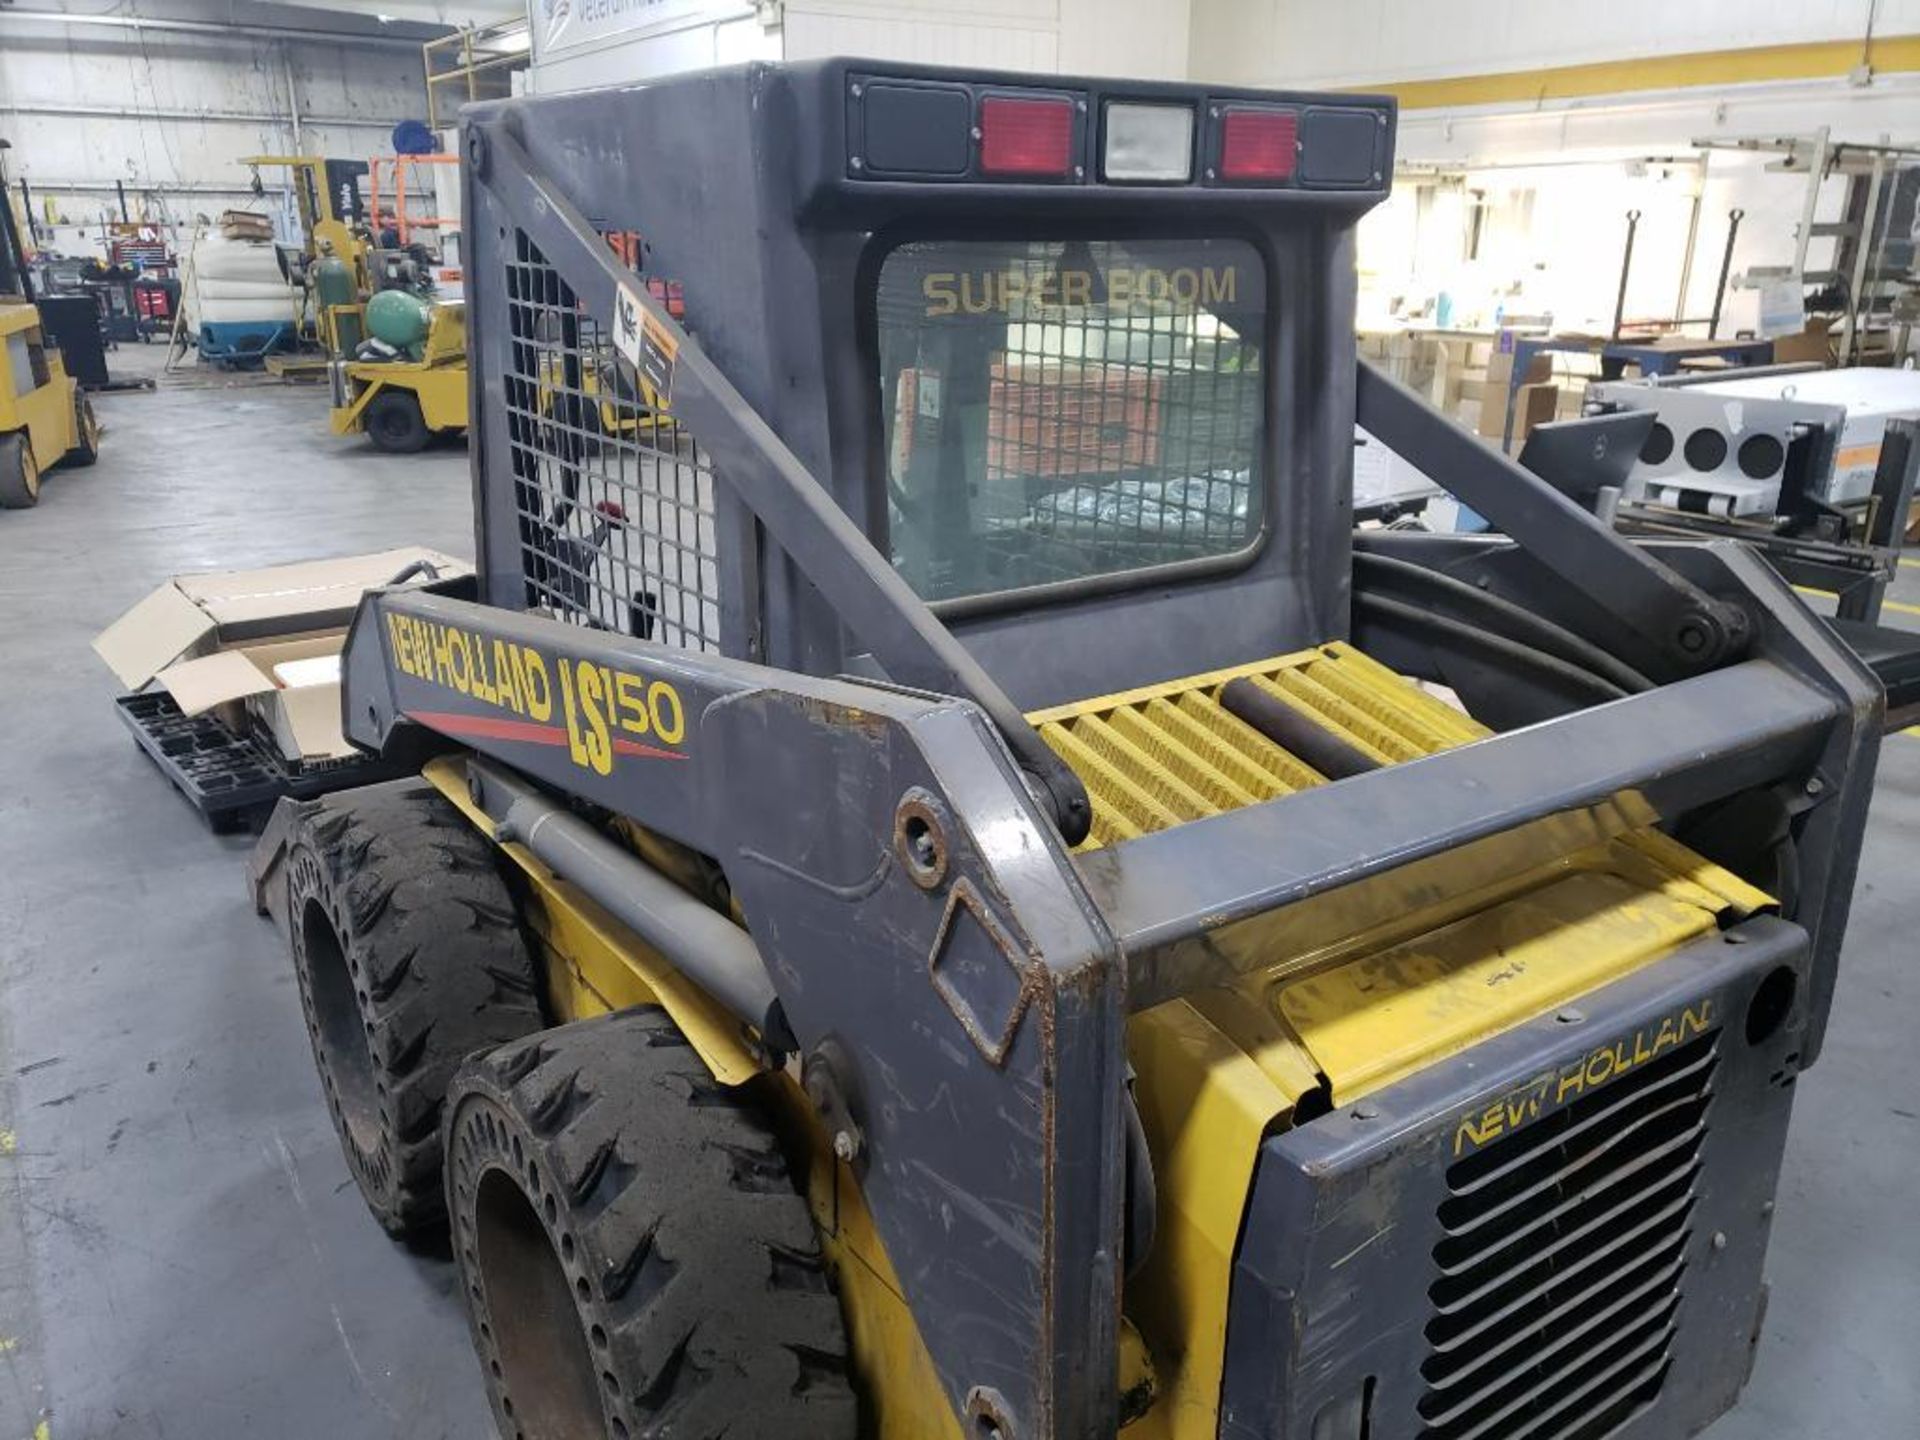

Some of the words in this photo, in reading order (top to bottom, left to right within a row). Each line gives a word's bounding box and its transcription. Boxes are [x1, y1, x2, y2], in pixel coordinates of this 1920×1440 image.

[922, 270, 1092, 316] SUPER
[1107, 266, 1236, 308] BOOM
[387, 612, 434, 682] NEW
[430, 622, 551, 722] HOLLAND
